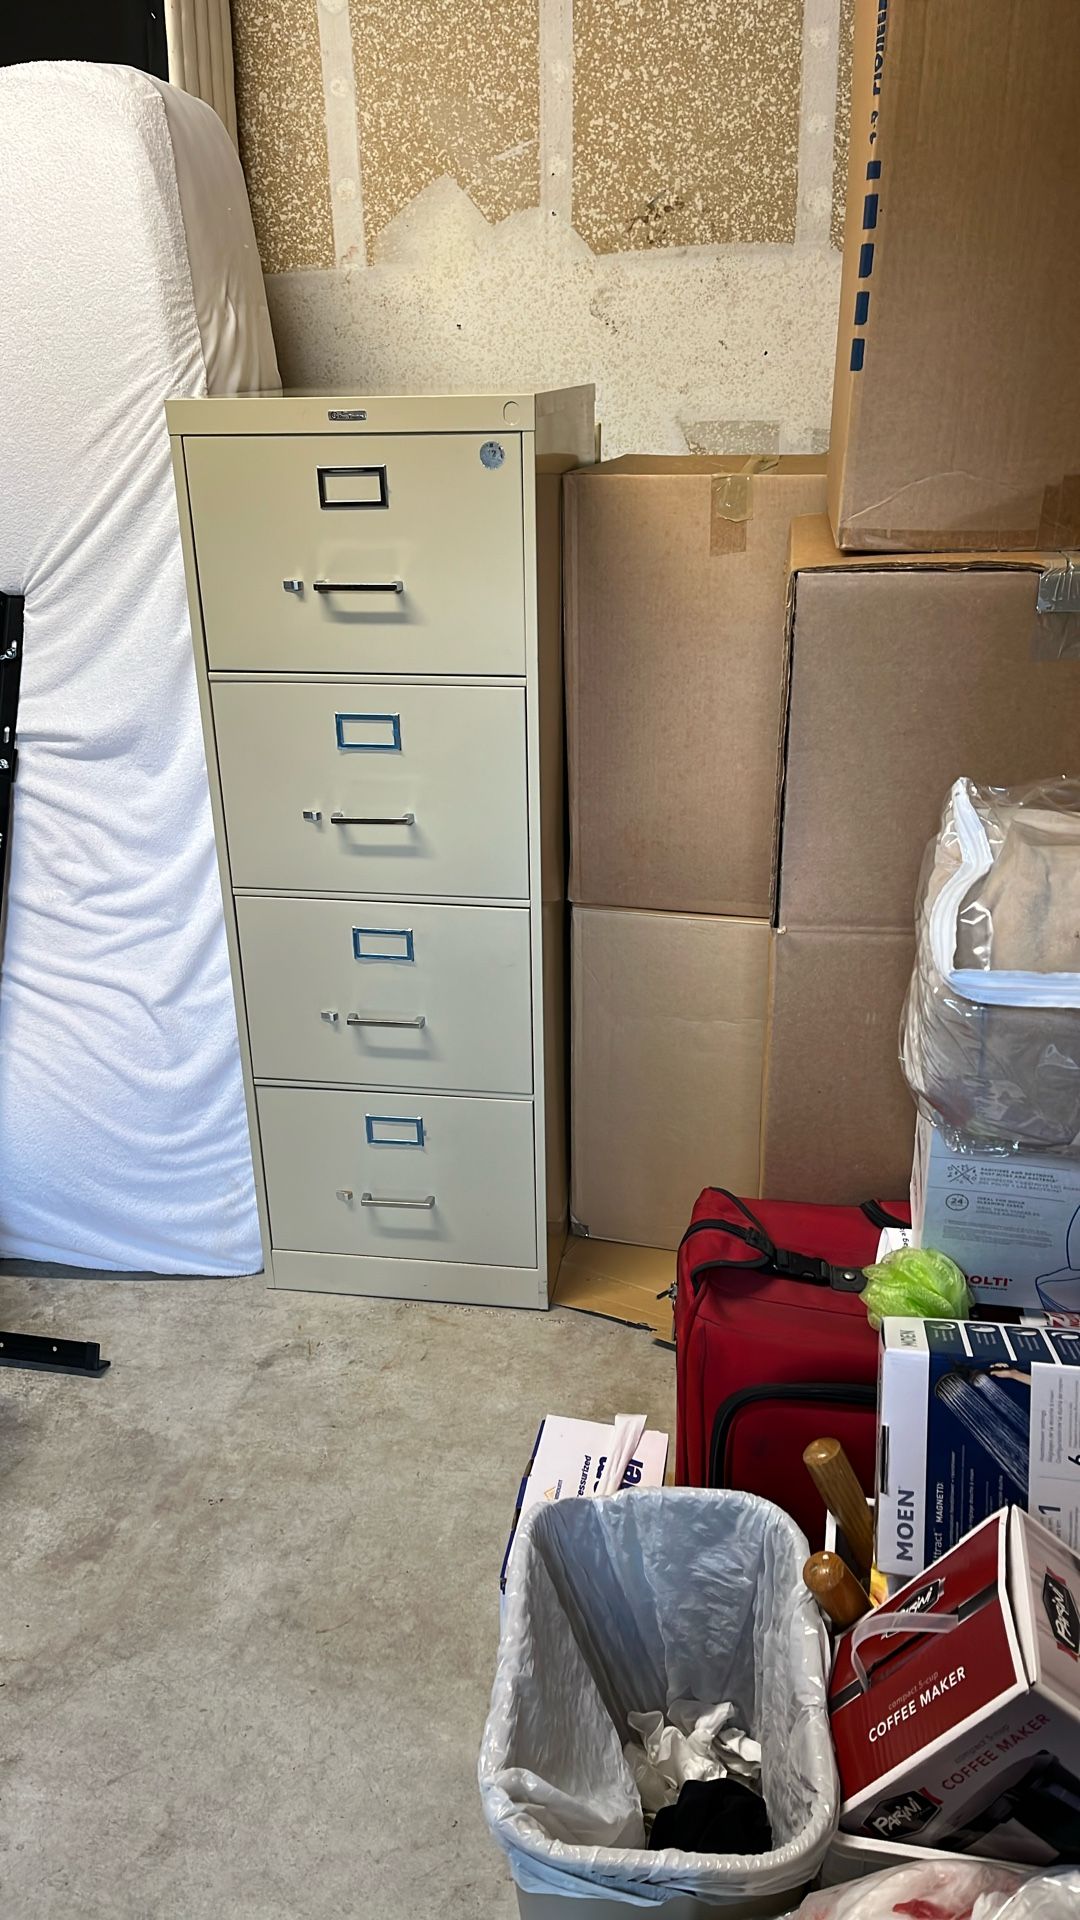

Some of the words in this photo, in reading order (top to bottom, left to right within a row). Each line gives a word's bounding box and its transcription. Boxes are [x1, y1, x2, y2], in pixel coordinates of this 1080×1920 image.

[950, 1198, 963, 1206] 24
[967, 1275, 1008, 1286] OLTI
[901, 1330, 916, 1347] MOEN
[576, 1454, 592, 1497] essurized
[896, 1490, 915, 1562] MOEN
[1038, 1504, 1061, 1515] 1
[933, 1531, 943, 1562] ttract
[868, 1699, 917, 1743] COFFEE
[919, 1666, 966, 1708] MAKER
[888, 1685, 918, 1711] compact
[918, 1671, 939, 1690] 5-cup
[942, 1750, 999, 1790] COFFEE
[995, 1713, 1051, 1753] MAKER
